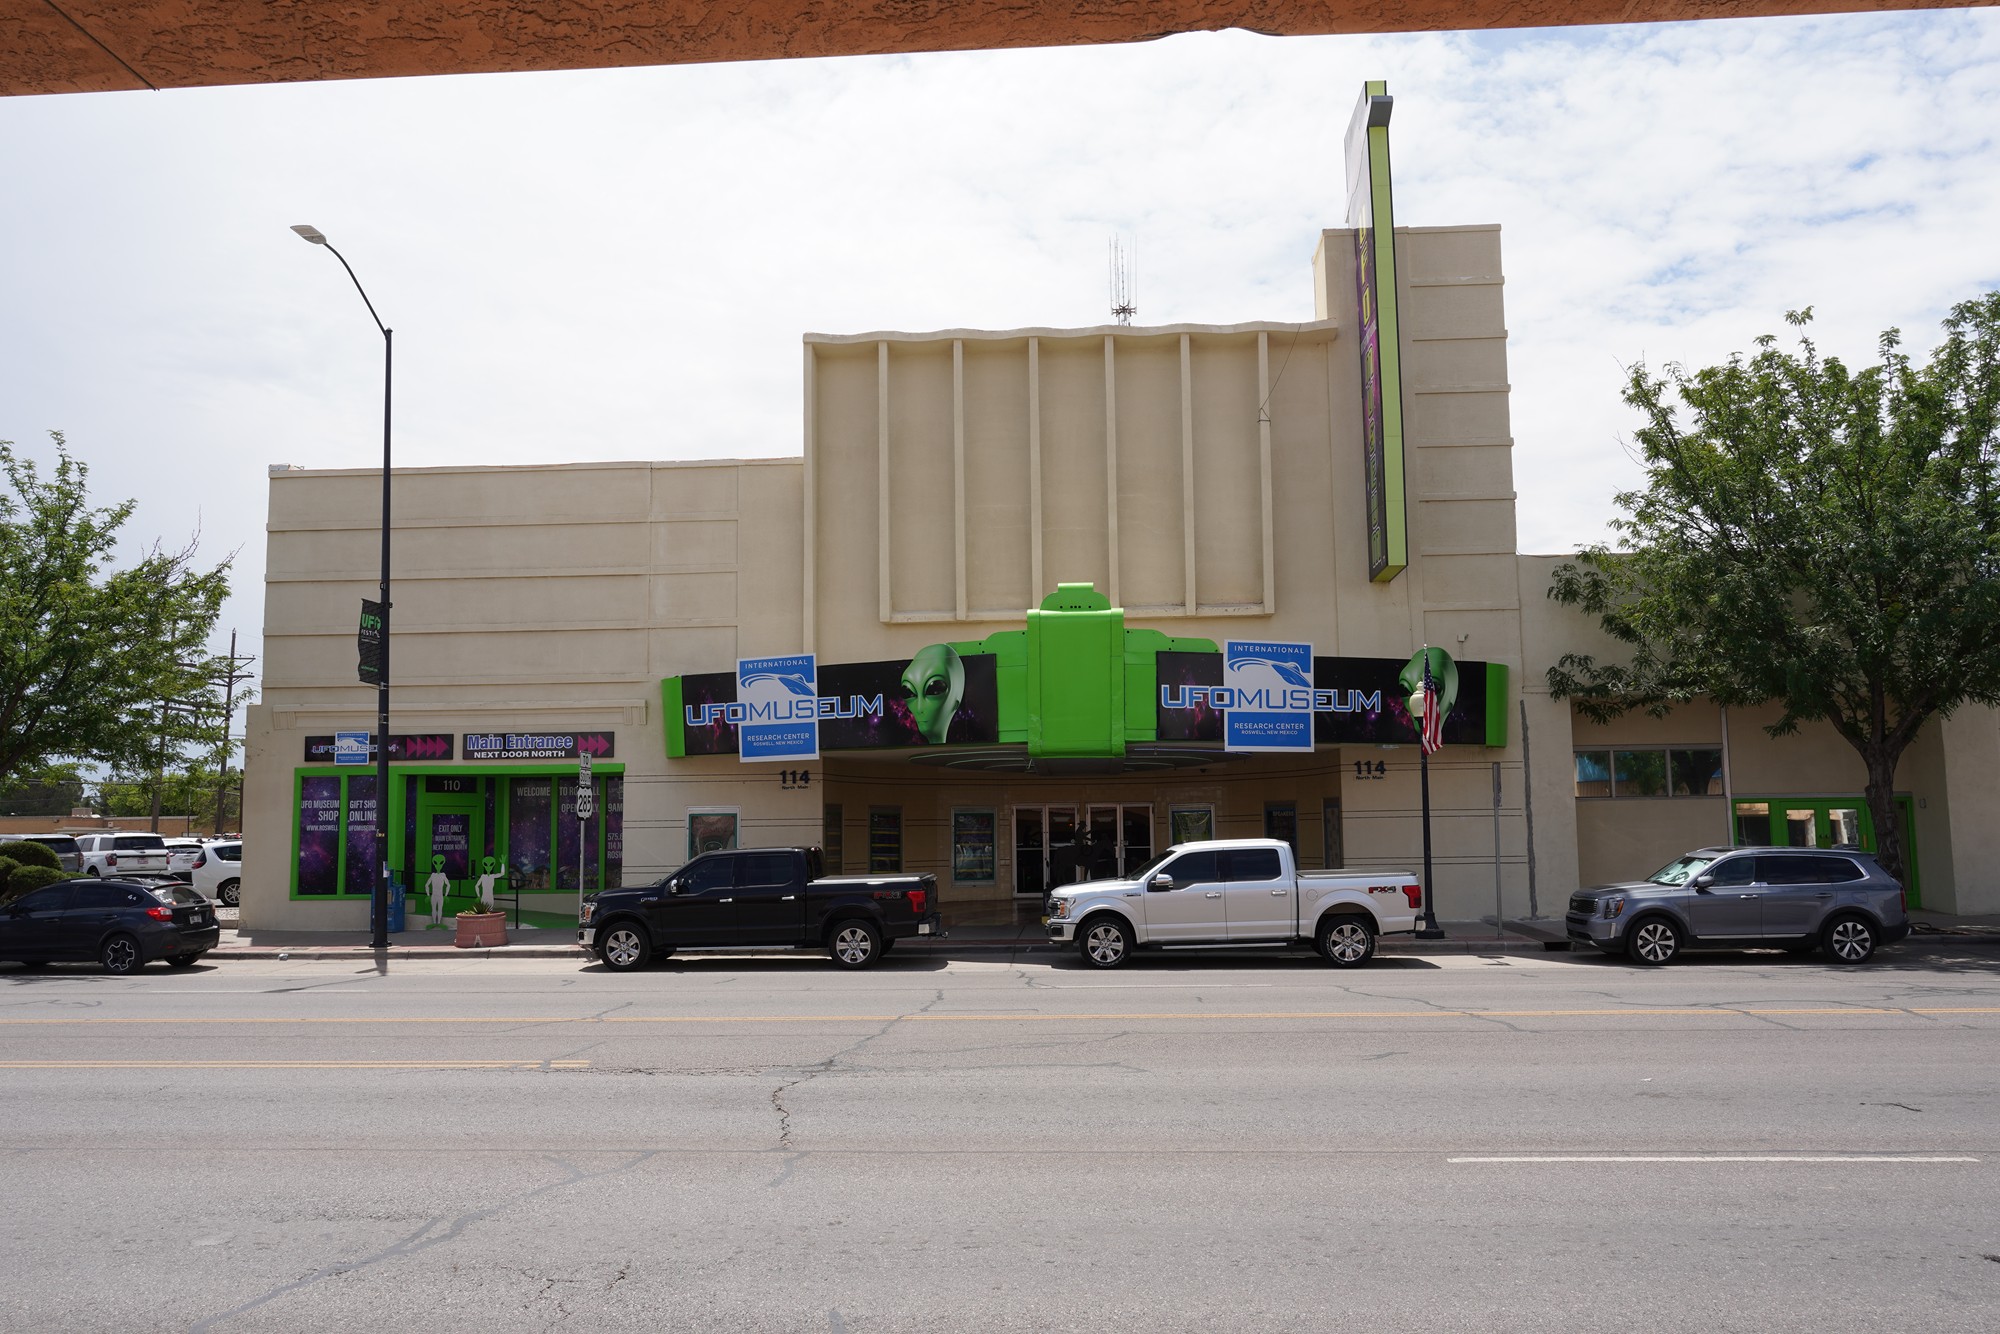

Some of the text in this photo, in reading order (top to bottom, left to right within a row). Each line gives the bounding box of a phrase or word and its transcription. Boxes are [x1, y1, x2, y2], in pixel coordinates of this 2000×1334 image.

[1234, 645, 1304, 654] INTERNATIONAL
[745, 659, 808, 669] INTERNATIONAL
[467, 733, 574, 750] Main Entrance
[747, 732, 810, 742] RESEARCH CENTER
[501, 750, 530, 758] DOOR
[1354, 760, 1386, 774] 114
[779, 770, 811, 784] 114
[443, 780, 461, 791] 110
[516, 787, 551, 797] WELCOME
[559, 786, 568, 796] TO
[301, 800, 377, 808] UFO MUSEUM GIFT SHO
[561, 803, 577, 813] OPE
[578, 794, 592, 813] 285
[318, 810, 377, 821] SHOP ONLINE
[438, 824, 463, 833] EXIT ONLY
[1368, 886, 1397, 894] FX4
